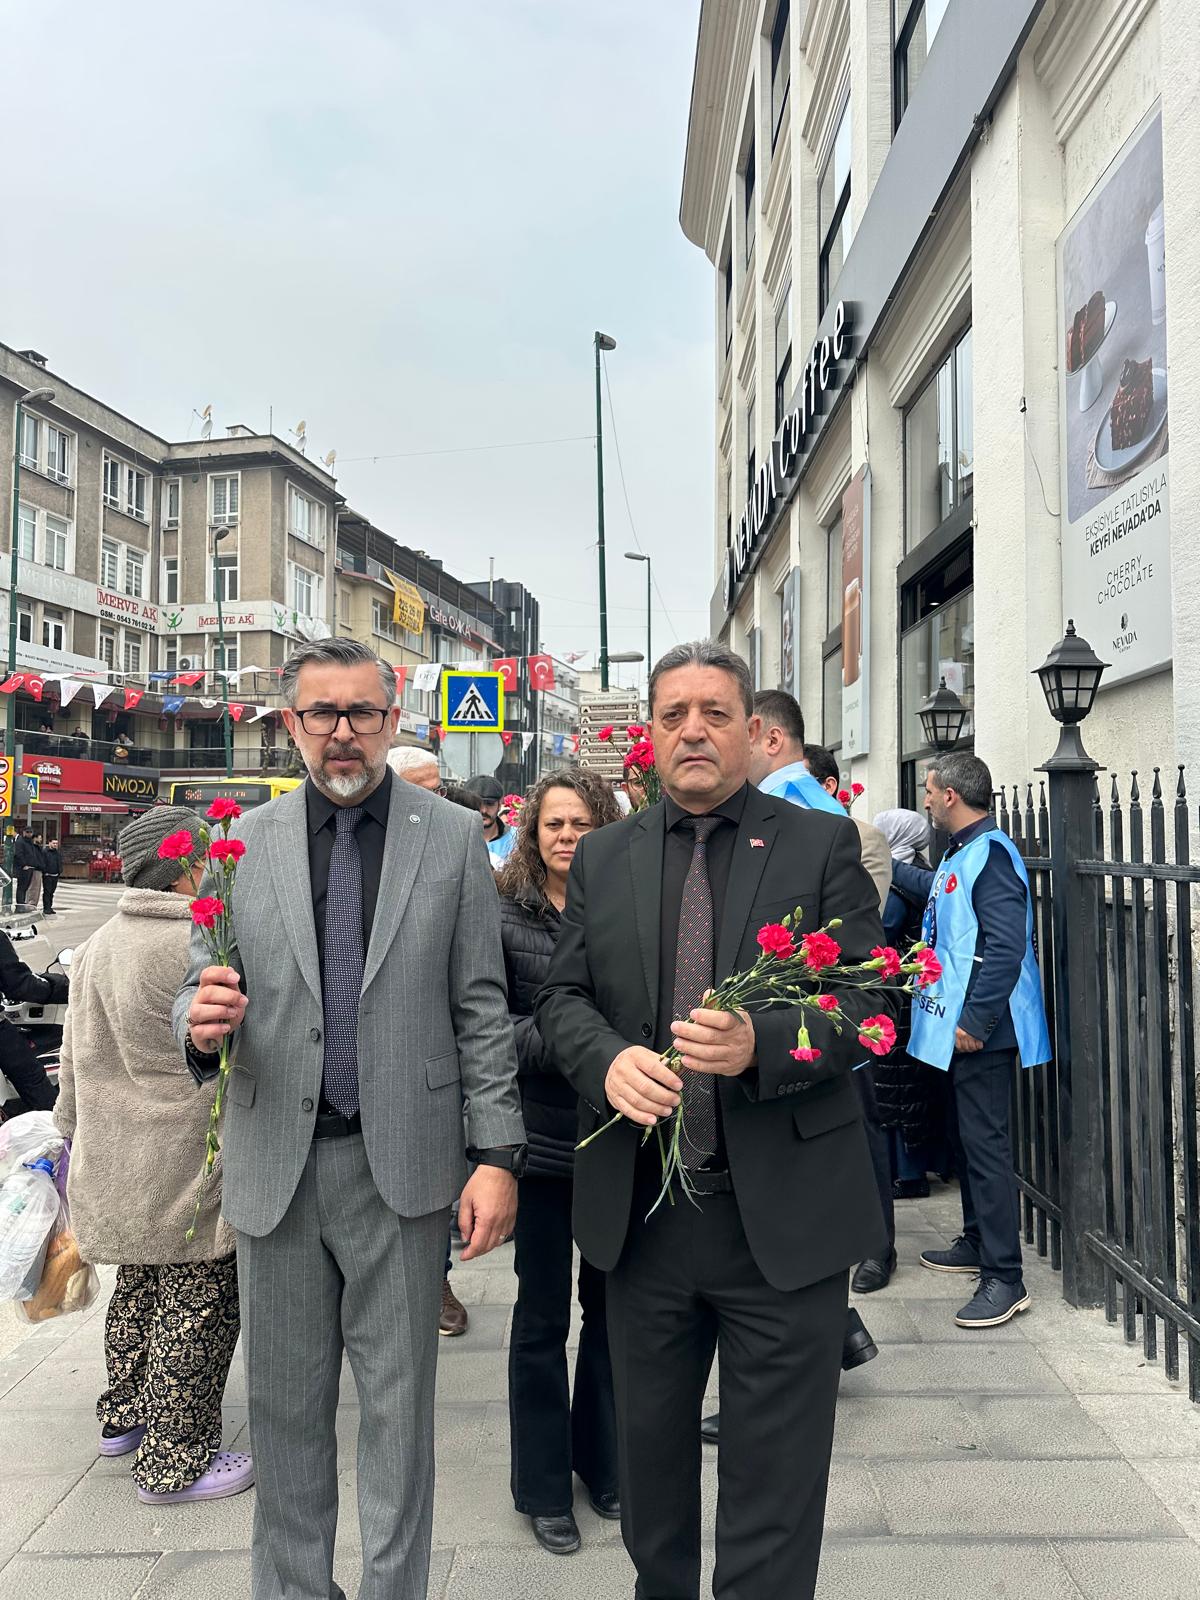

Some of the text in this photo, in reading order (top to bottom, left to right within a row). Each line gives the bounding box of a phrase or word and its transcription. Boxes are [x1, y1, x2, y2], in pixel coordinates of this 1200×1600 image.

[1085, 473, 1168, 541] EKŞİSİYLE TATLISIYLA
[1090, 499, 1162, 558] KEYFİ NEVADA'DA
[1097, 564, 1154, 605] CHOCOLATE
[1106, 555, 1143, 585] CHERRY
[98, 590, 157, 621] MERVE AK
[100, 609, 116, 620] GSM:
[238, 615, 253, 624] AK
